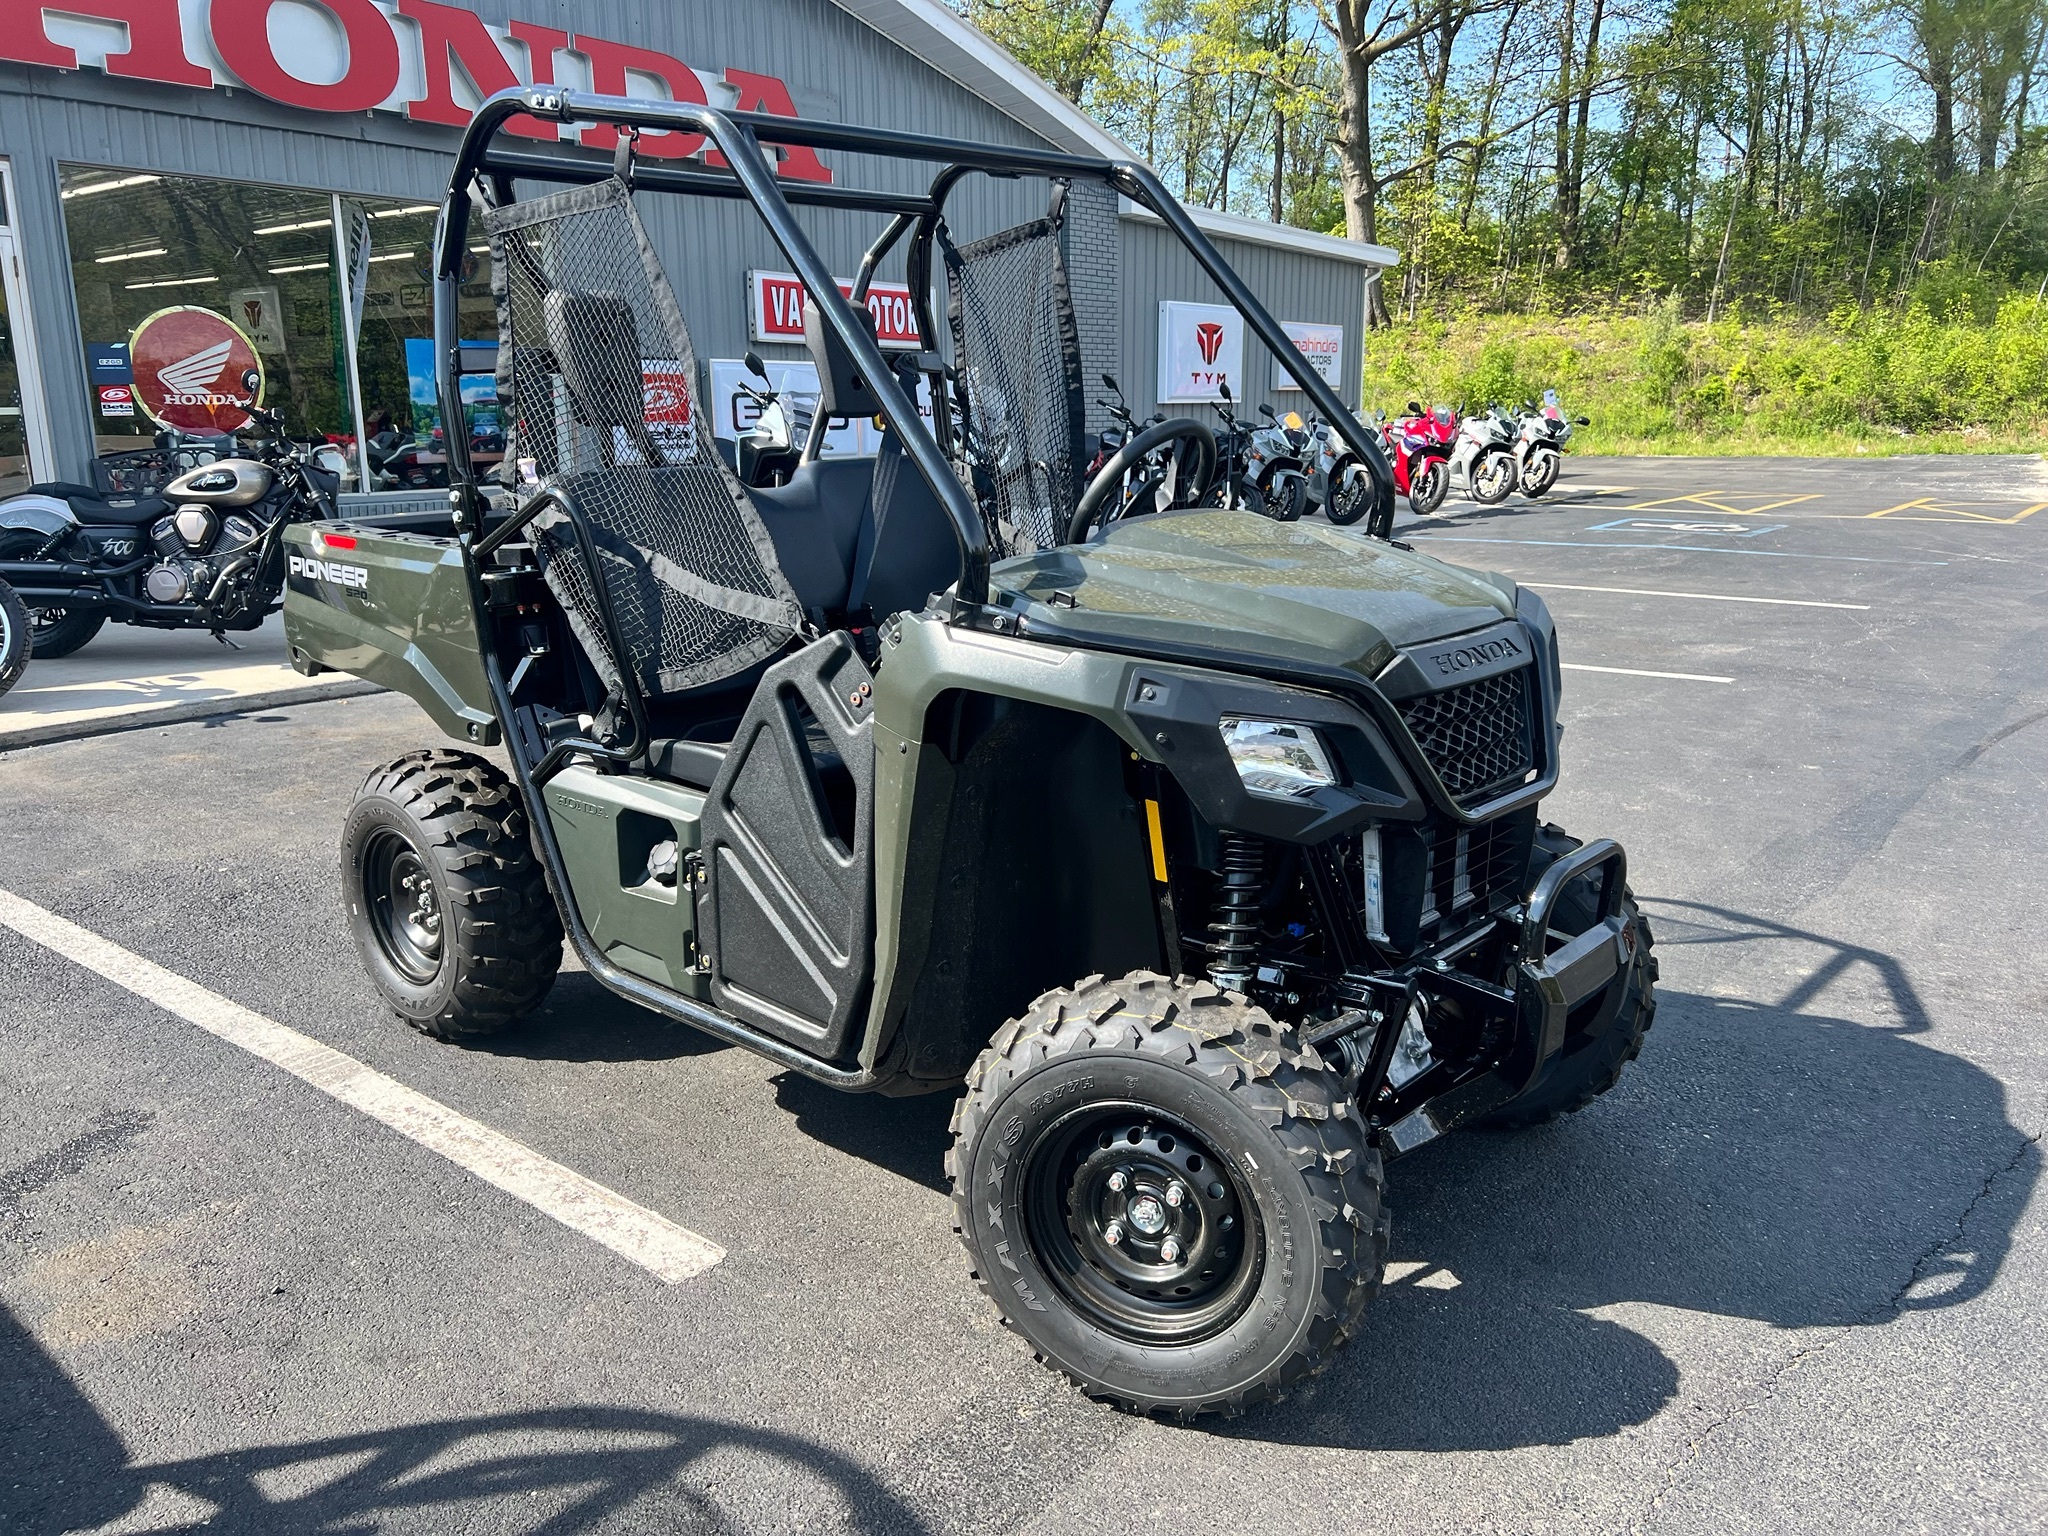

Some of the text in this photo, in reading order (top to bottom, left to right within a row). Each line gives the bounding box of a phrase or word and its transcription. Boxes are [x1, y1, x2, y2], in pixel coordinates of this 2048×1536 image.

[1303, 355, 1332, 365] ACTORS
[1191, 372, 1226, 385] TYM
[163, 394, 238, 405] HONDA
[100, 538, 135, 556] 500
[289, 555, 368, 589] PIONEER
[345, 587, 368, 600] 520
[1429, 637, 1523, 675] HONDA
[555, 793, 609, 819] HONDA
[987, 1115, 1048, 1312] MAXXIS
[1263, 1294, 1288, 1332] NHS
